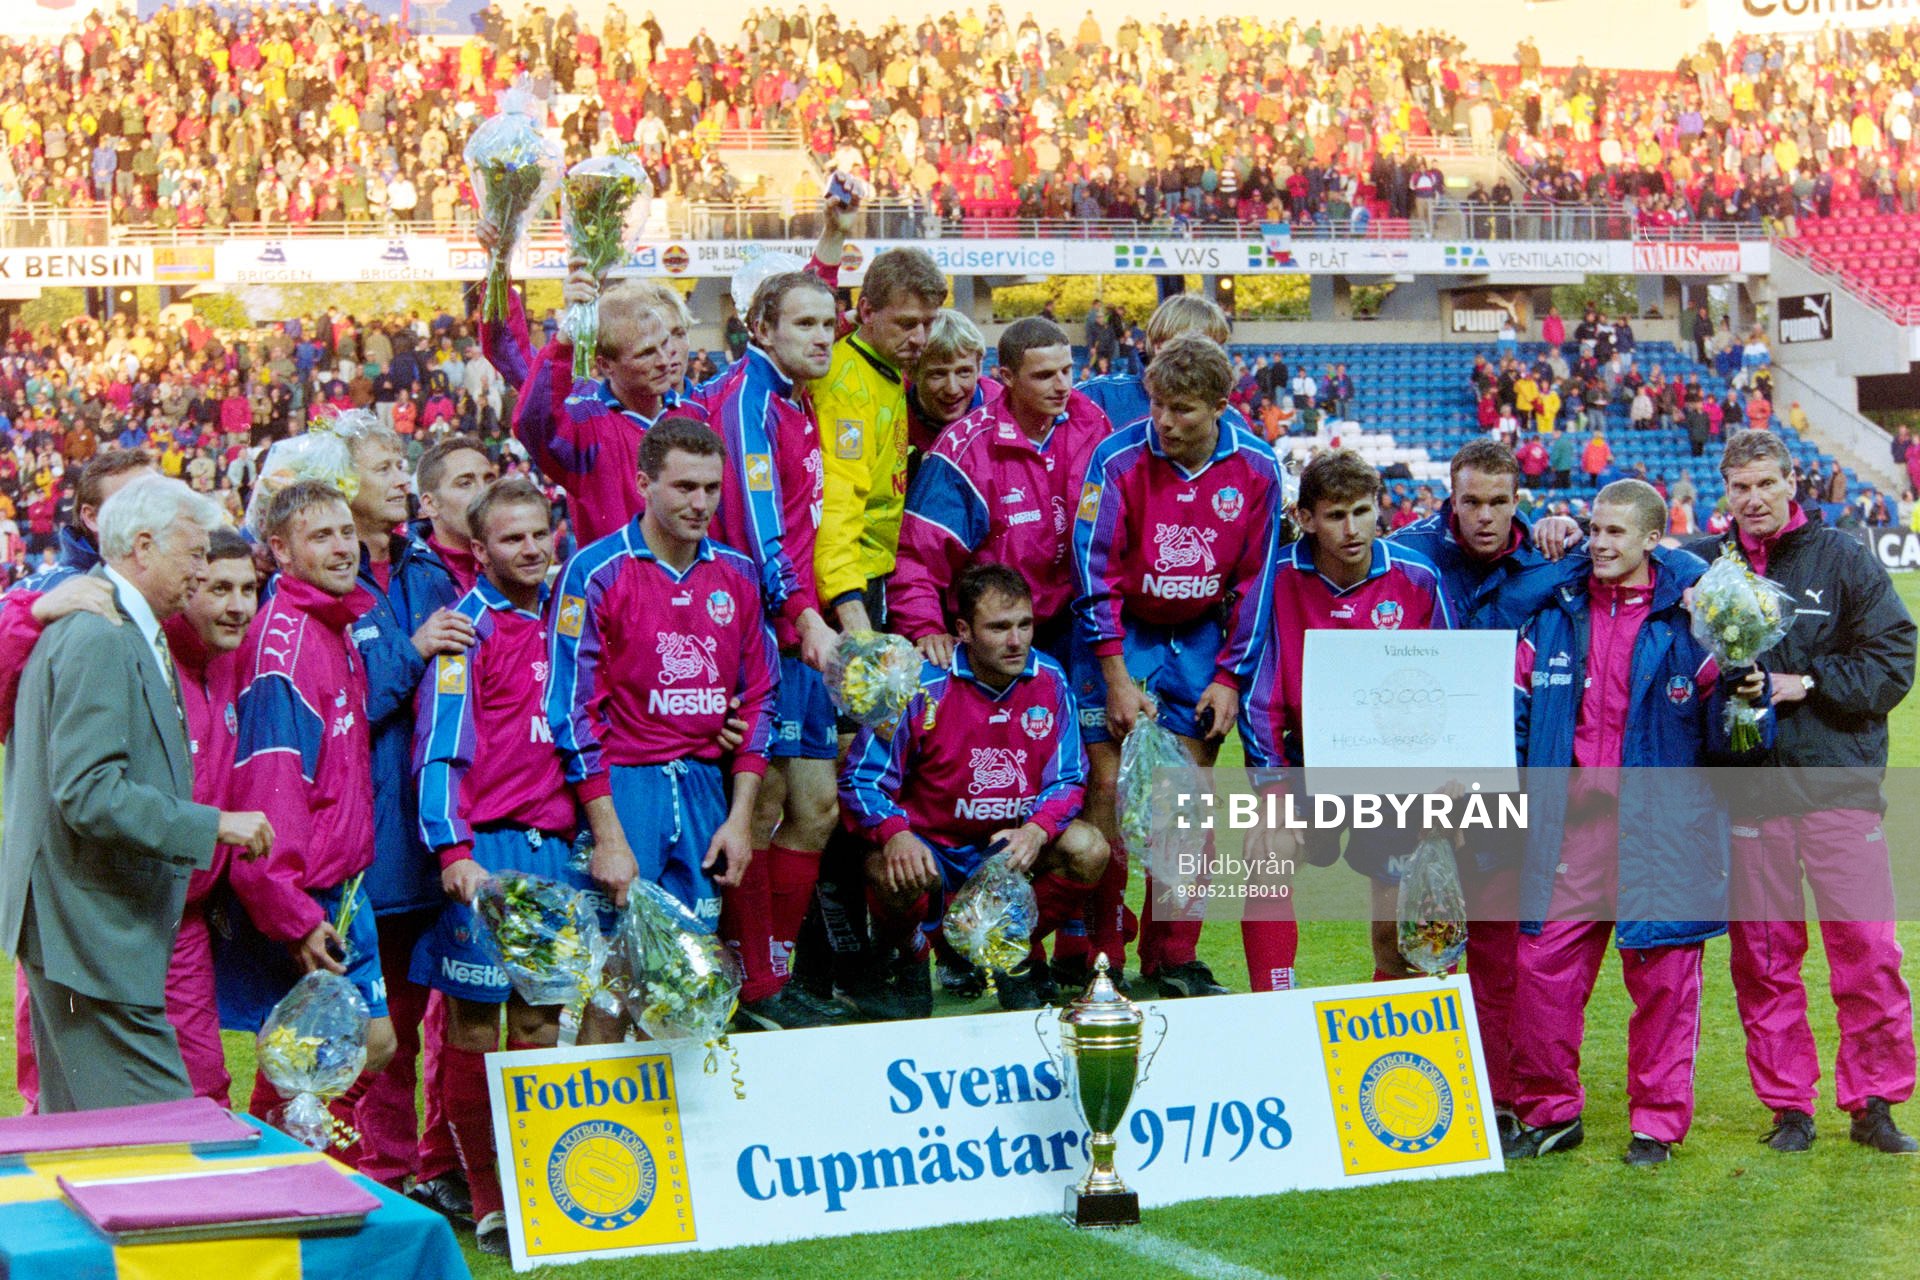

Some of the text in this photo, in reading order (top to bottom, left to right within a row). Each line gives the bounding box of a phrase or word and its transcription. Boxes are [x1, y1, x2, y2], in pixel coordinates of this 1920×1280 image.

[26, 254, 142, 278] BENSIN
[361, 267, 434, 280] BRIGGEN
[1499, 252, 1602, 268] VENTILATION
[237, 269, 312, 281] BRIGGEN
[1323, 995, 1460, 1044] Fotboll
[511, 1061, 671, 1113] Fotboll
[886, 1057, 1062, 1114] Svens
[559, 1122, 618, 1151] FOTBOLL
[1130, 1097, 1293, 1171] 97/98
